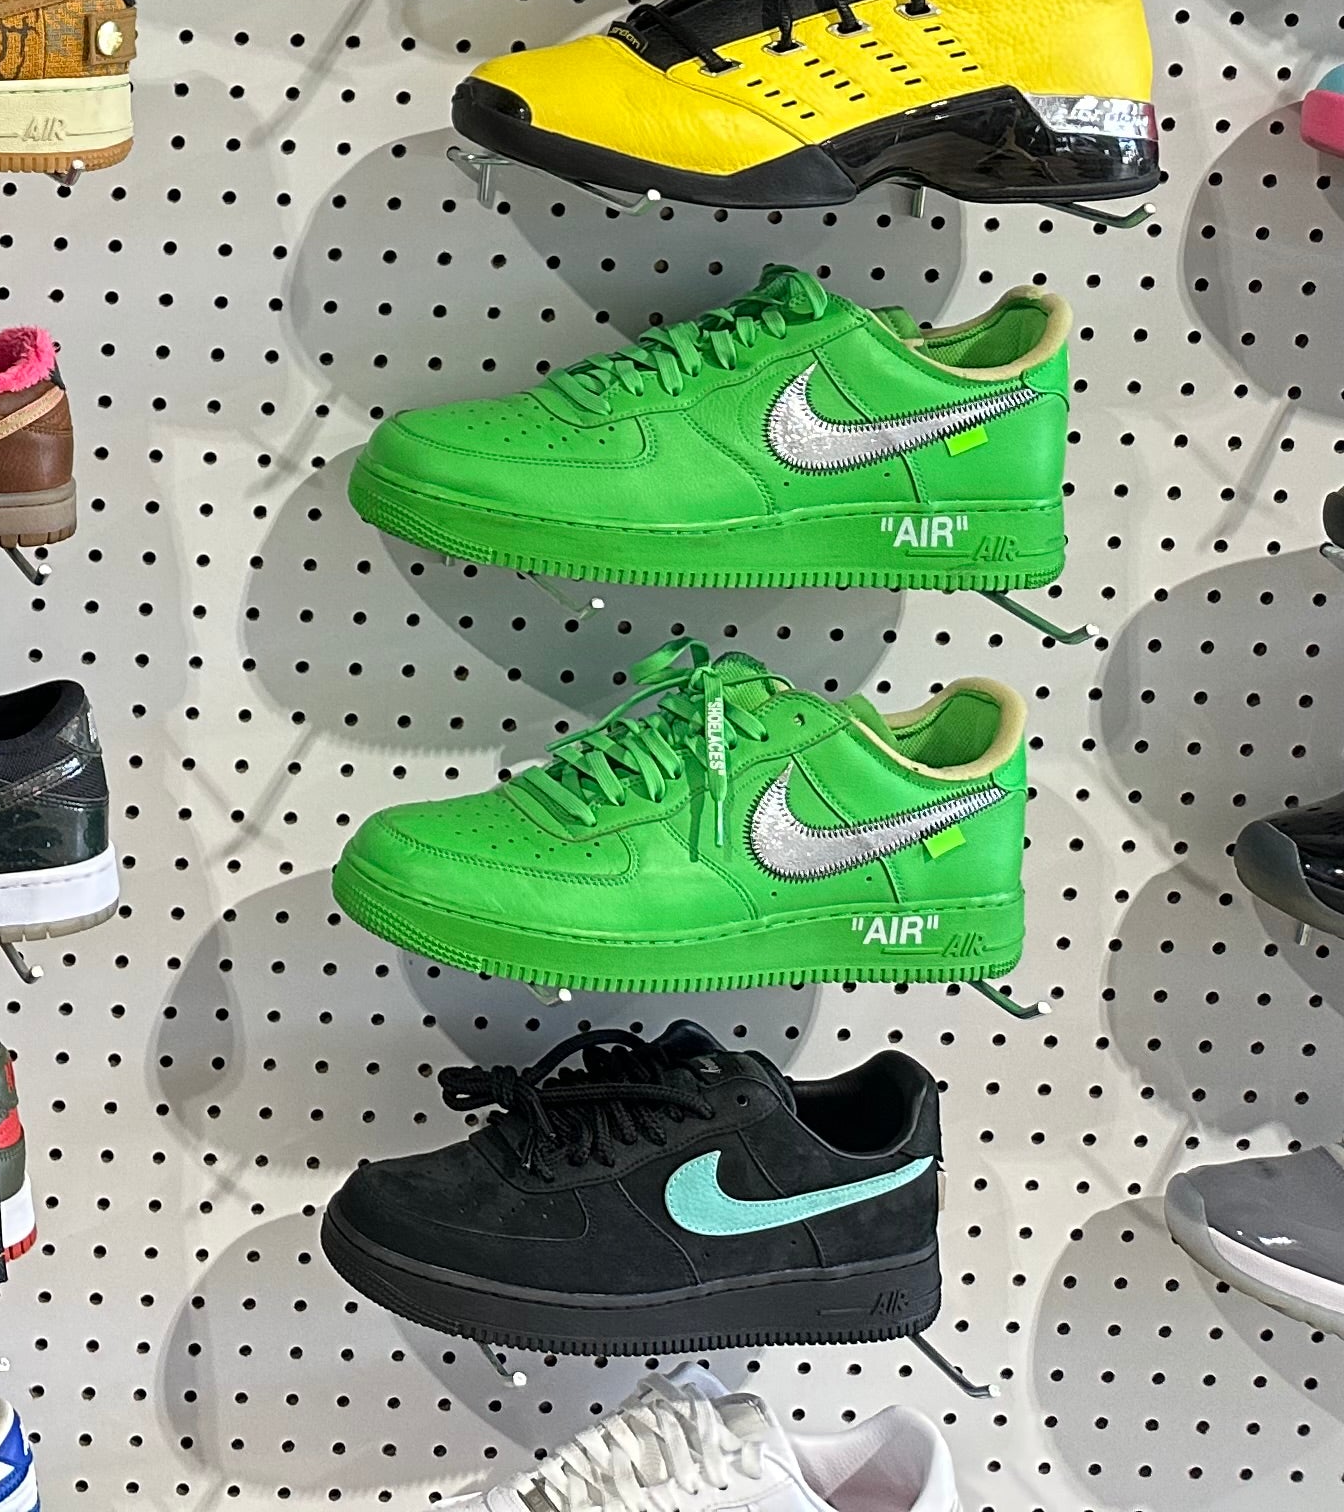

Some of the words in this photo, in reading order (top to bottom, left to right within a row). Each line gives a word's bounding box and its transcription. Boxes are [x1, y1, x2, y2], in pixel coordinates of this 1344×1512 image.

[21, 116, 67, 142] AIR
[880, 515, 969, 548] "AIR"
[971, 534, 1018, 562] AIR
[851, 914, 940, 945] "AIR"
[941, 932, 987, 958] AIR
[869, 1289, 910, 1316] AIR
